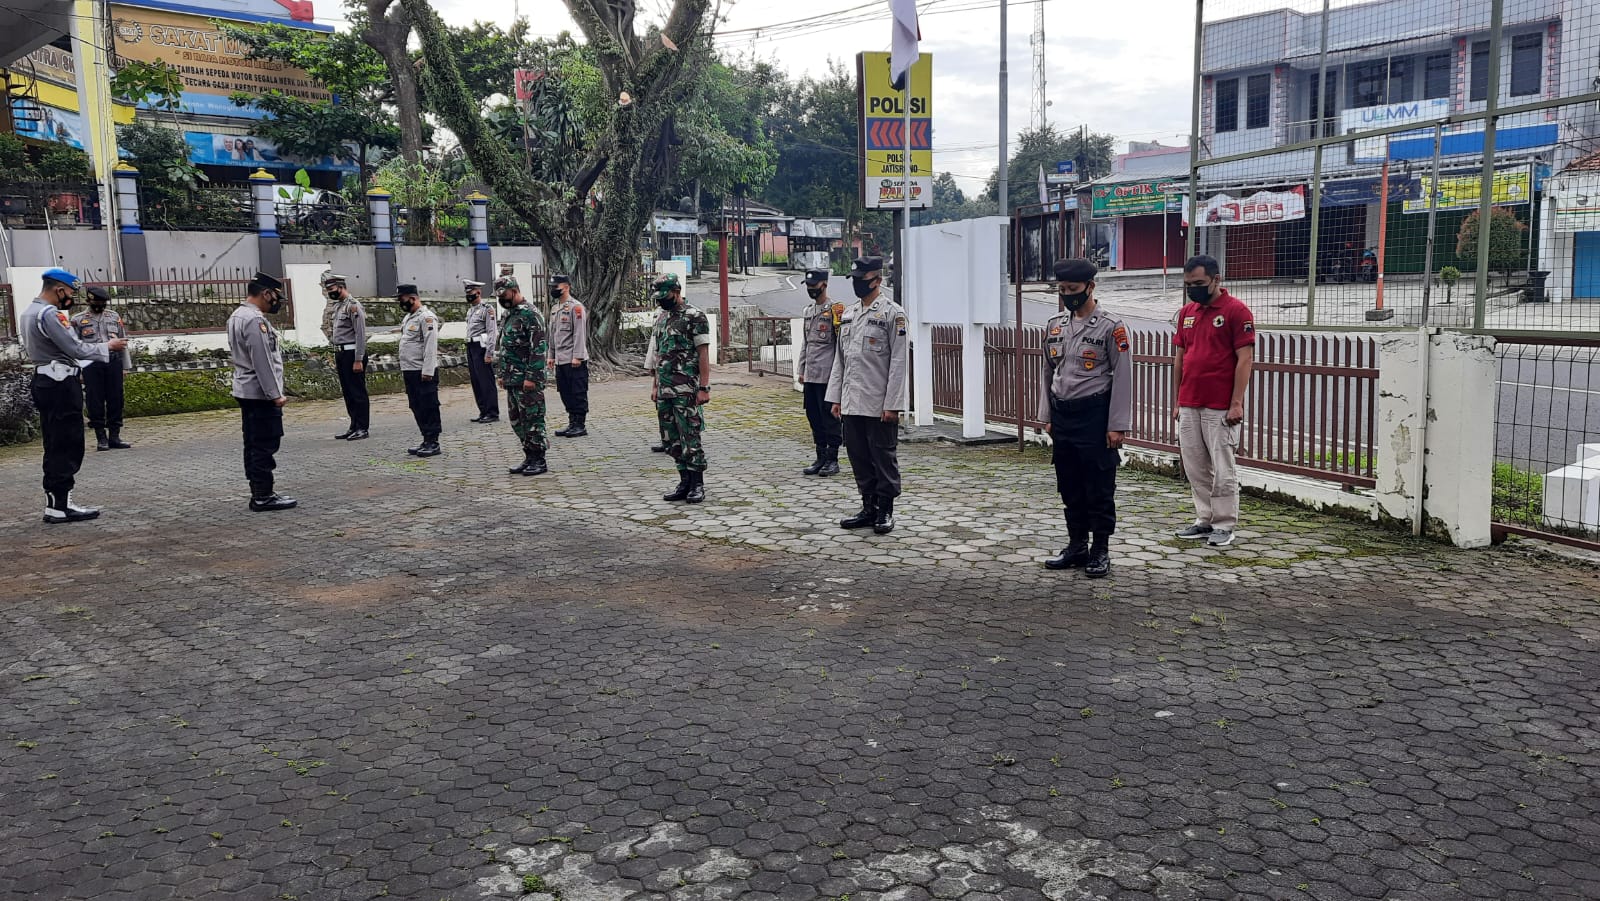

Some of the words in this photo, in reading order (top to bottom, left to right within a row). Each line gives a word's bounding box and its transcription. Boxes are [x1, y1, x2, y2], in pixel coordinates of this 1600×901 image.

[149, 24, 219, 53] SAKAT
[219, 55, 252, 68] MOTOR
[205, 68, 230, 78] SEPEDA
[231, 72, 254, 81] MOTOR
[254, 74, 278, 84] SEGALA
[185, 77, 211, 88] SECARA
[870, 97, 926, 114] POLSI
[886, 153, 913, 163] POLSK
[880, 164, 918, 174] JATISRNO
[867, 319, 887, 328] POLRI
[1081, 336, 1104, 346] POLRI
